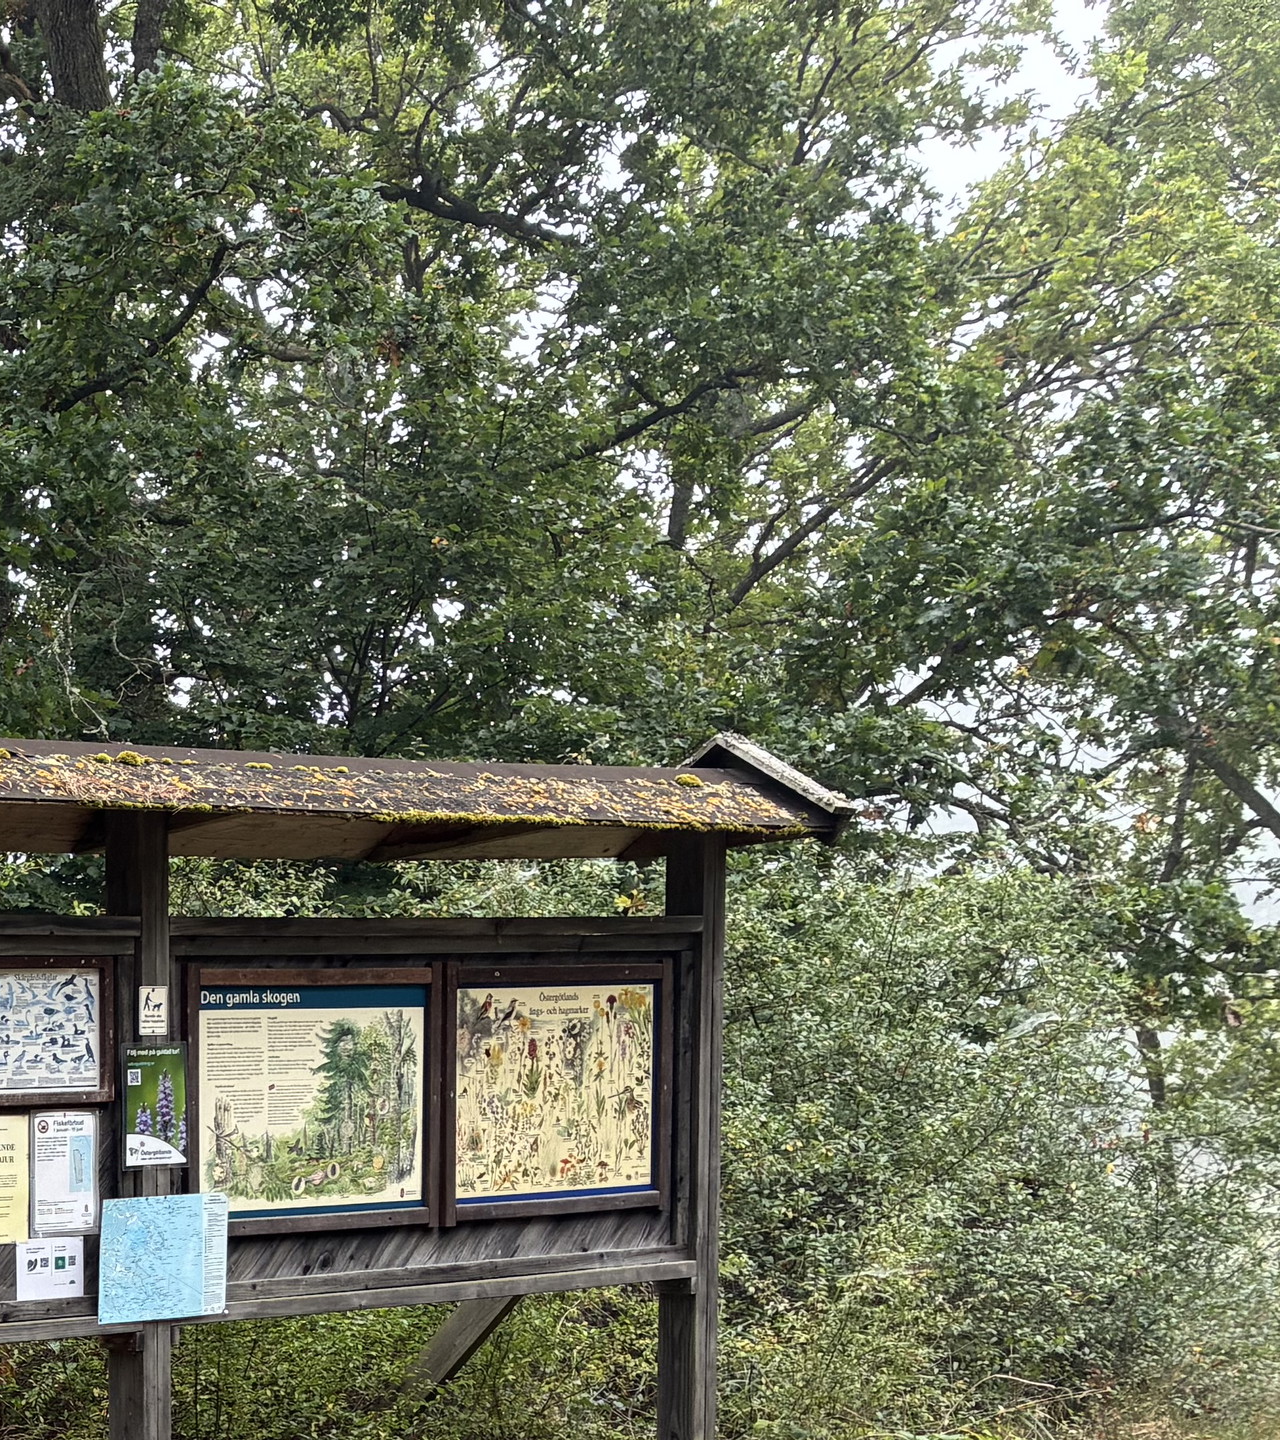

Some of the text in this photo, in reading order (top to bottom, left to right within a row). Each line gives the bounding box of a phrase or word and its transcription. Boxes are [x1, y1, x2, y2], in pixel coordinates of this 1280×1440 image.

[200, 989, 301, 1007] Den gamla skogen
